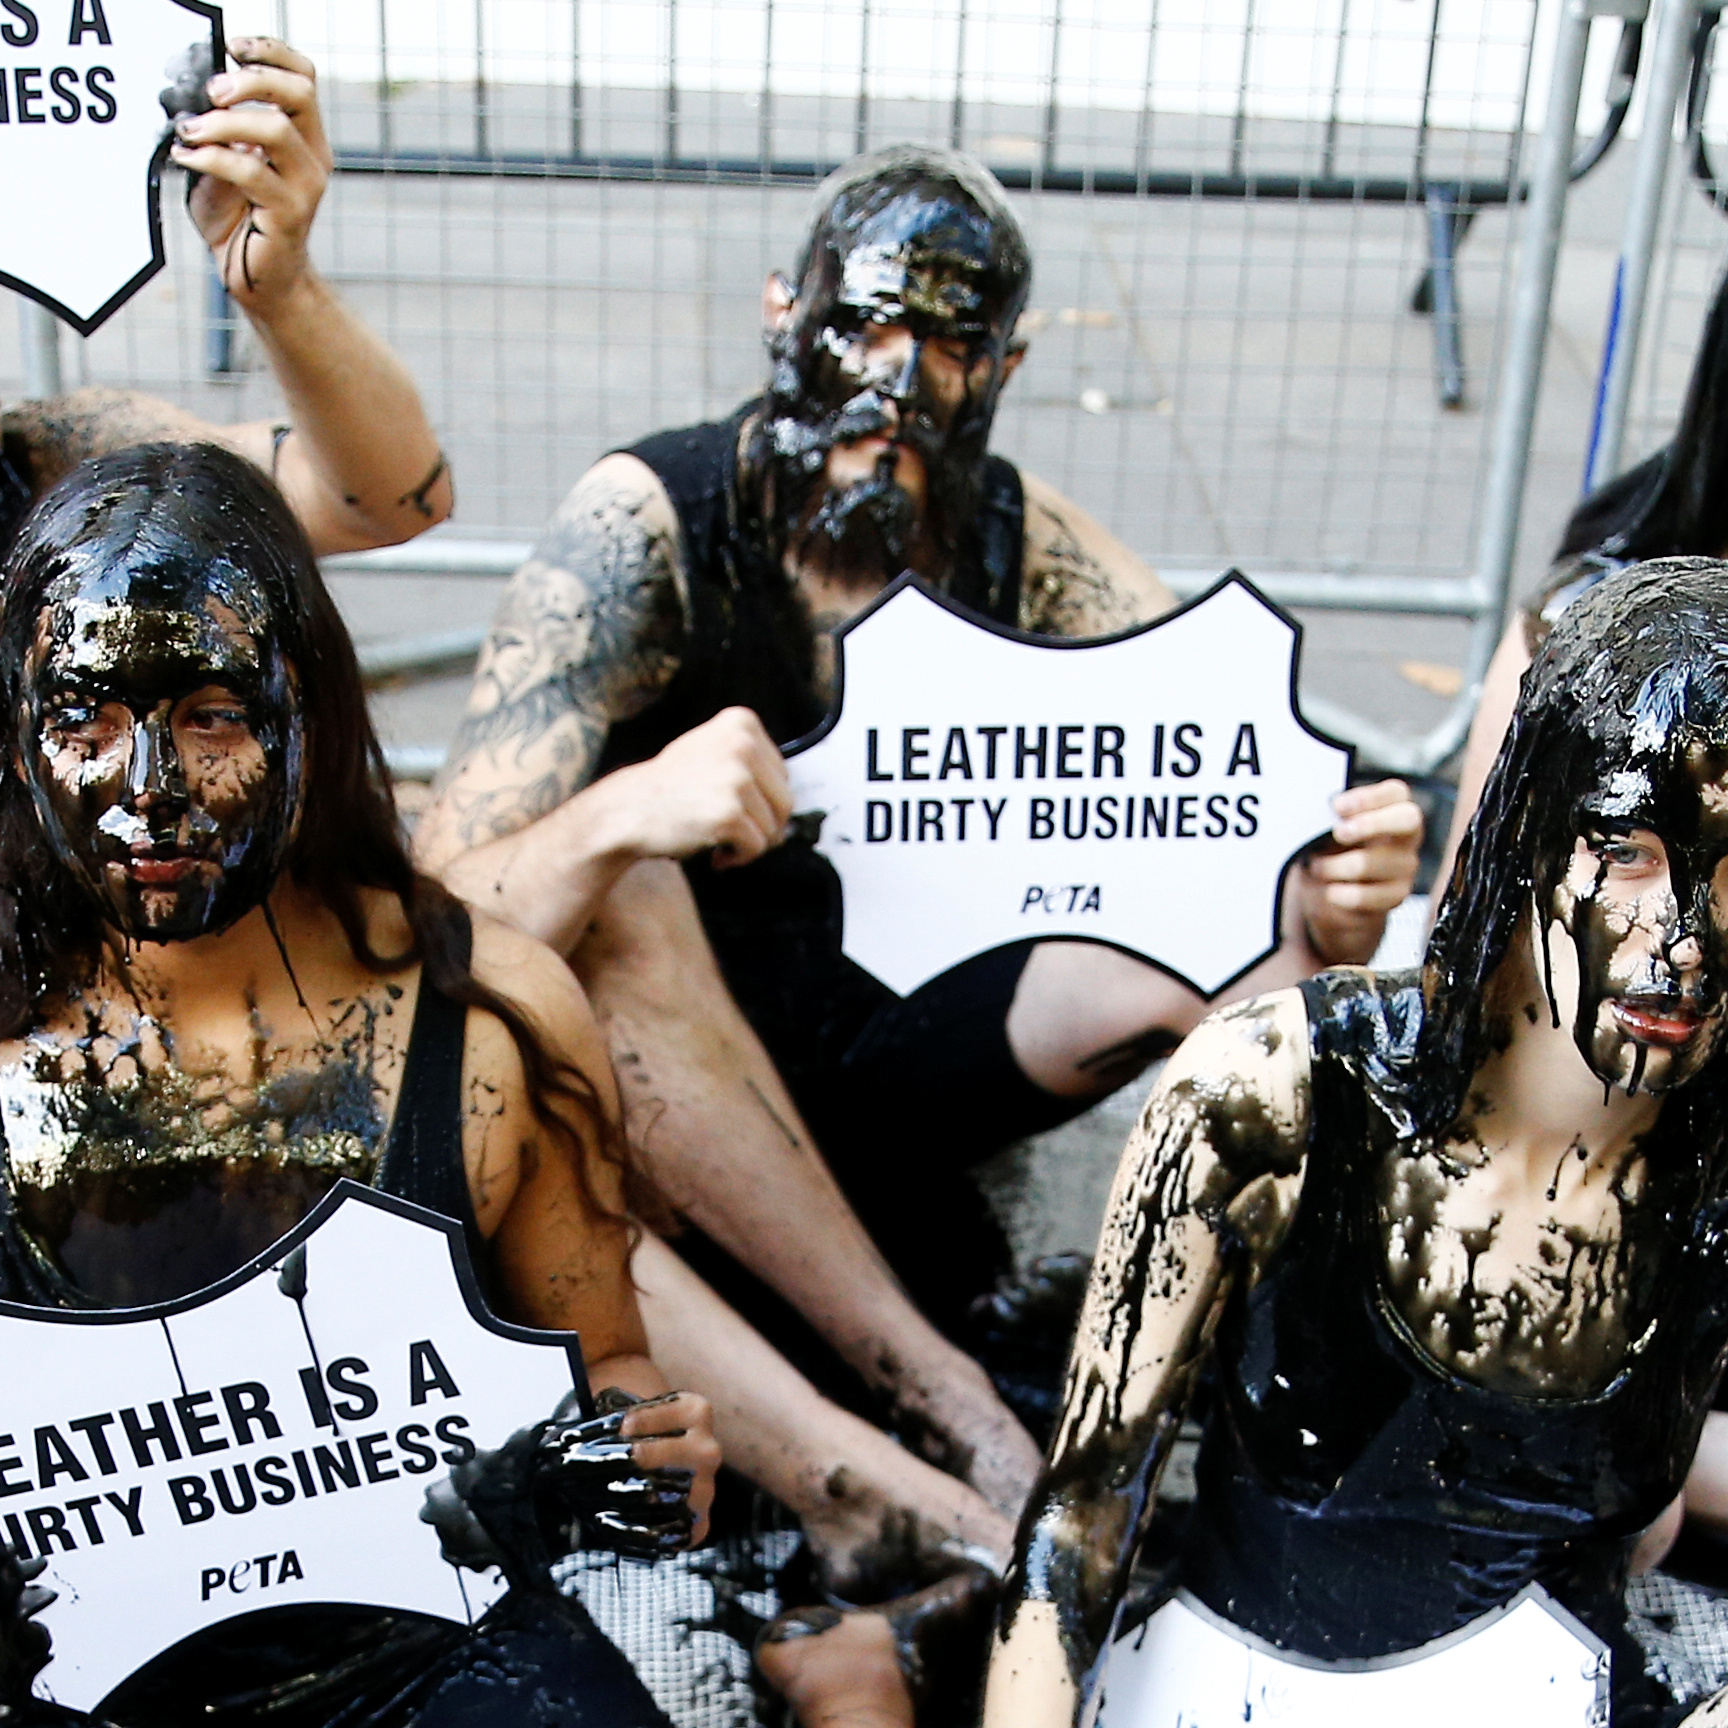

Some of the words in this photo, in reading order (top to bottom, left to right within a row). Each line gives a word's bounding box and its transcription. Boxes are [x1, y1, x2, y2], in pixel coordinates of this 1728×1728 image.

[69, 0, 113, 46] A
[866, 725, 1126, 782] LEATHER
[1152, 722, 1203, 778] IS
[1226, 723, 1262, 777] A
[865, 797, 1009, 843] DIRTY
[1029, 795, 1260, 840] BUSINESS
[298, 1356, 379, 1428] IS
[409, 1340, 461, 1407] A
[168, 1414, 476, 1526] BUSINESS
